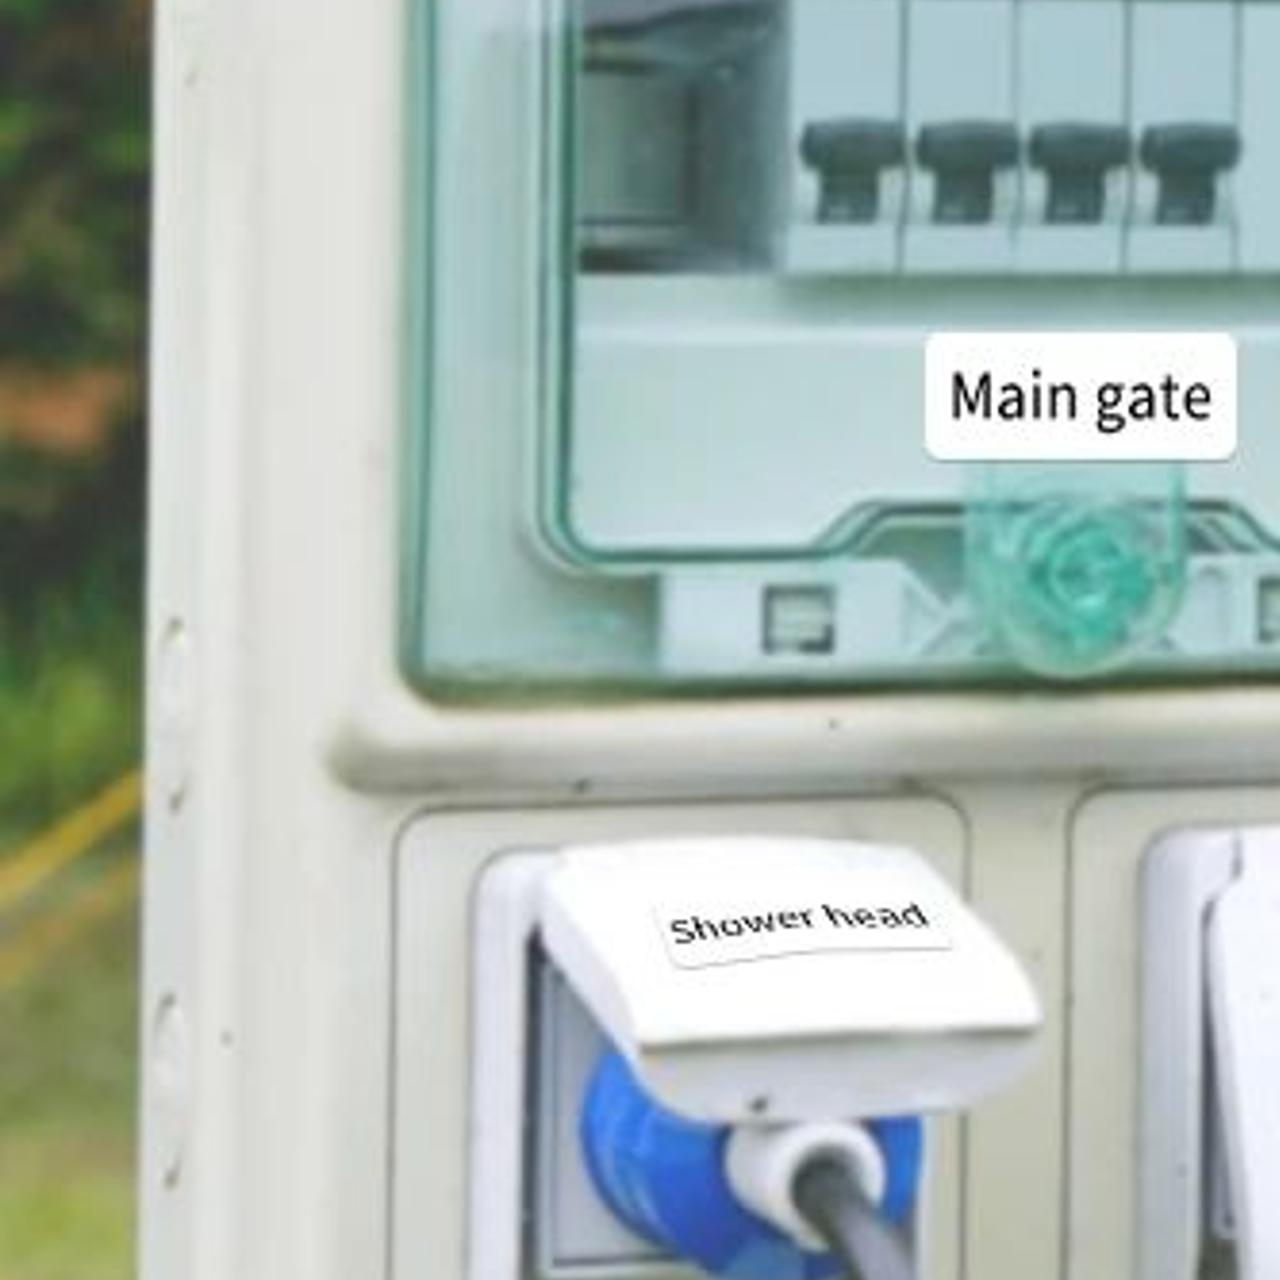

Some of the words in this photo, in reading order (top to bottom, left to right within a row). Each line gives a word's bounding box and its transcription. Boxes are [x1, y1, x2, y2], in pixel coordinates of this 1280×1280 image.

[951, 367, 1078, 422] Main
[1095, 373, 1212, 436] gate
[669, 909, 813, 946] Shower
[820, 902, 930, 928] head
